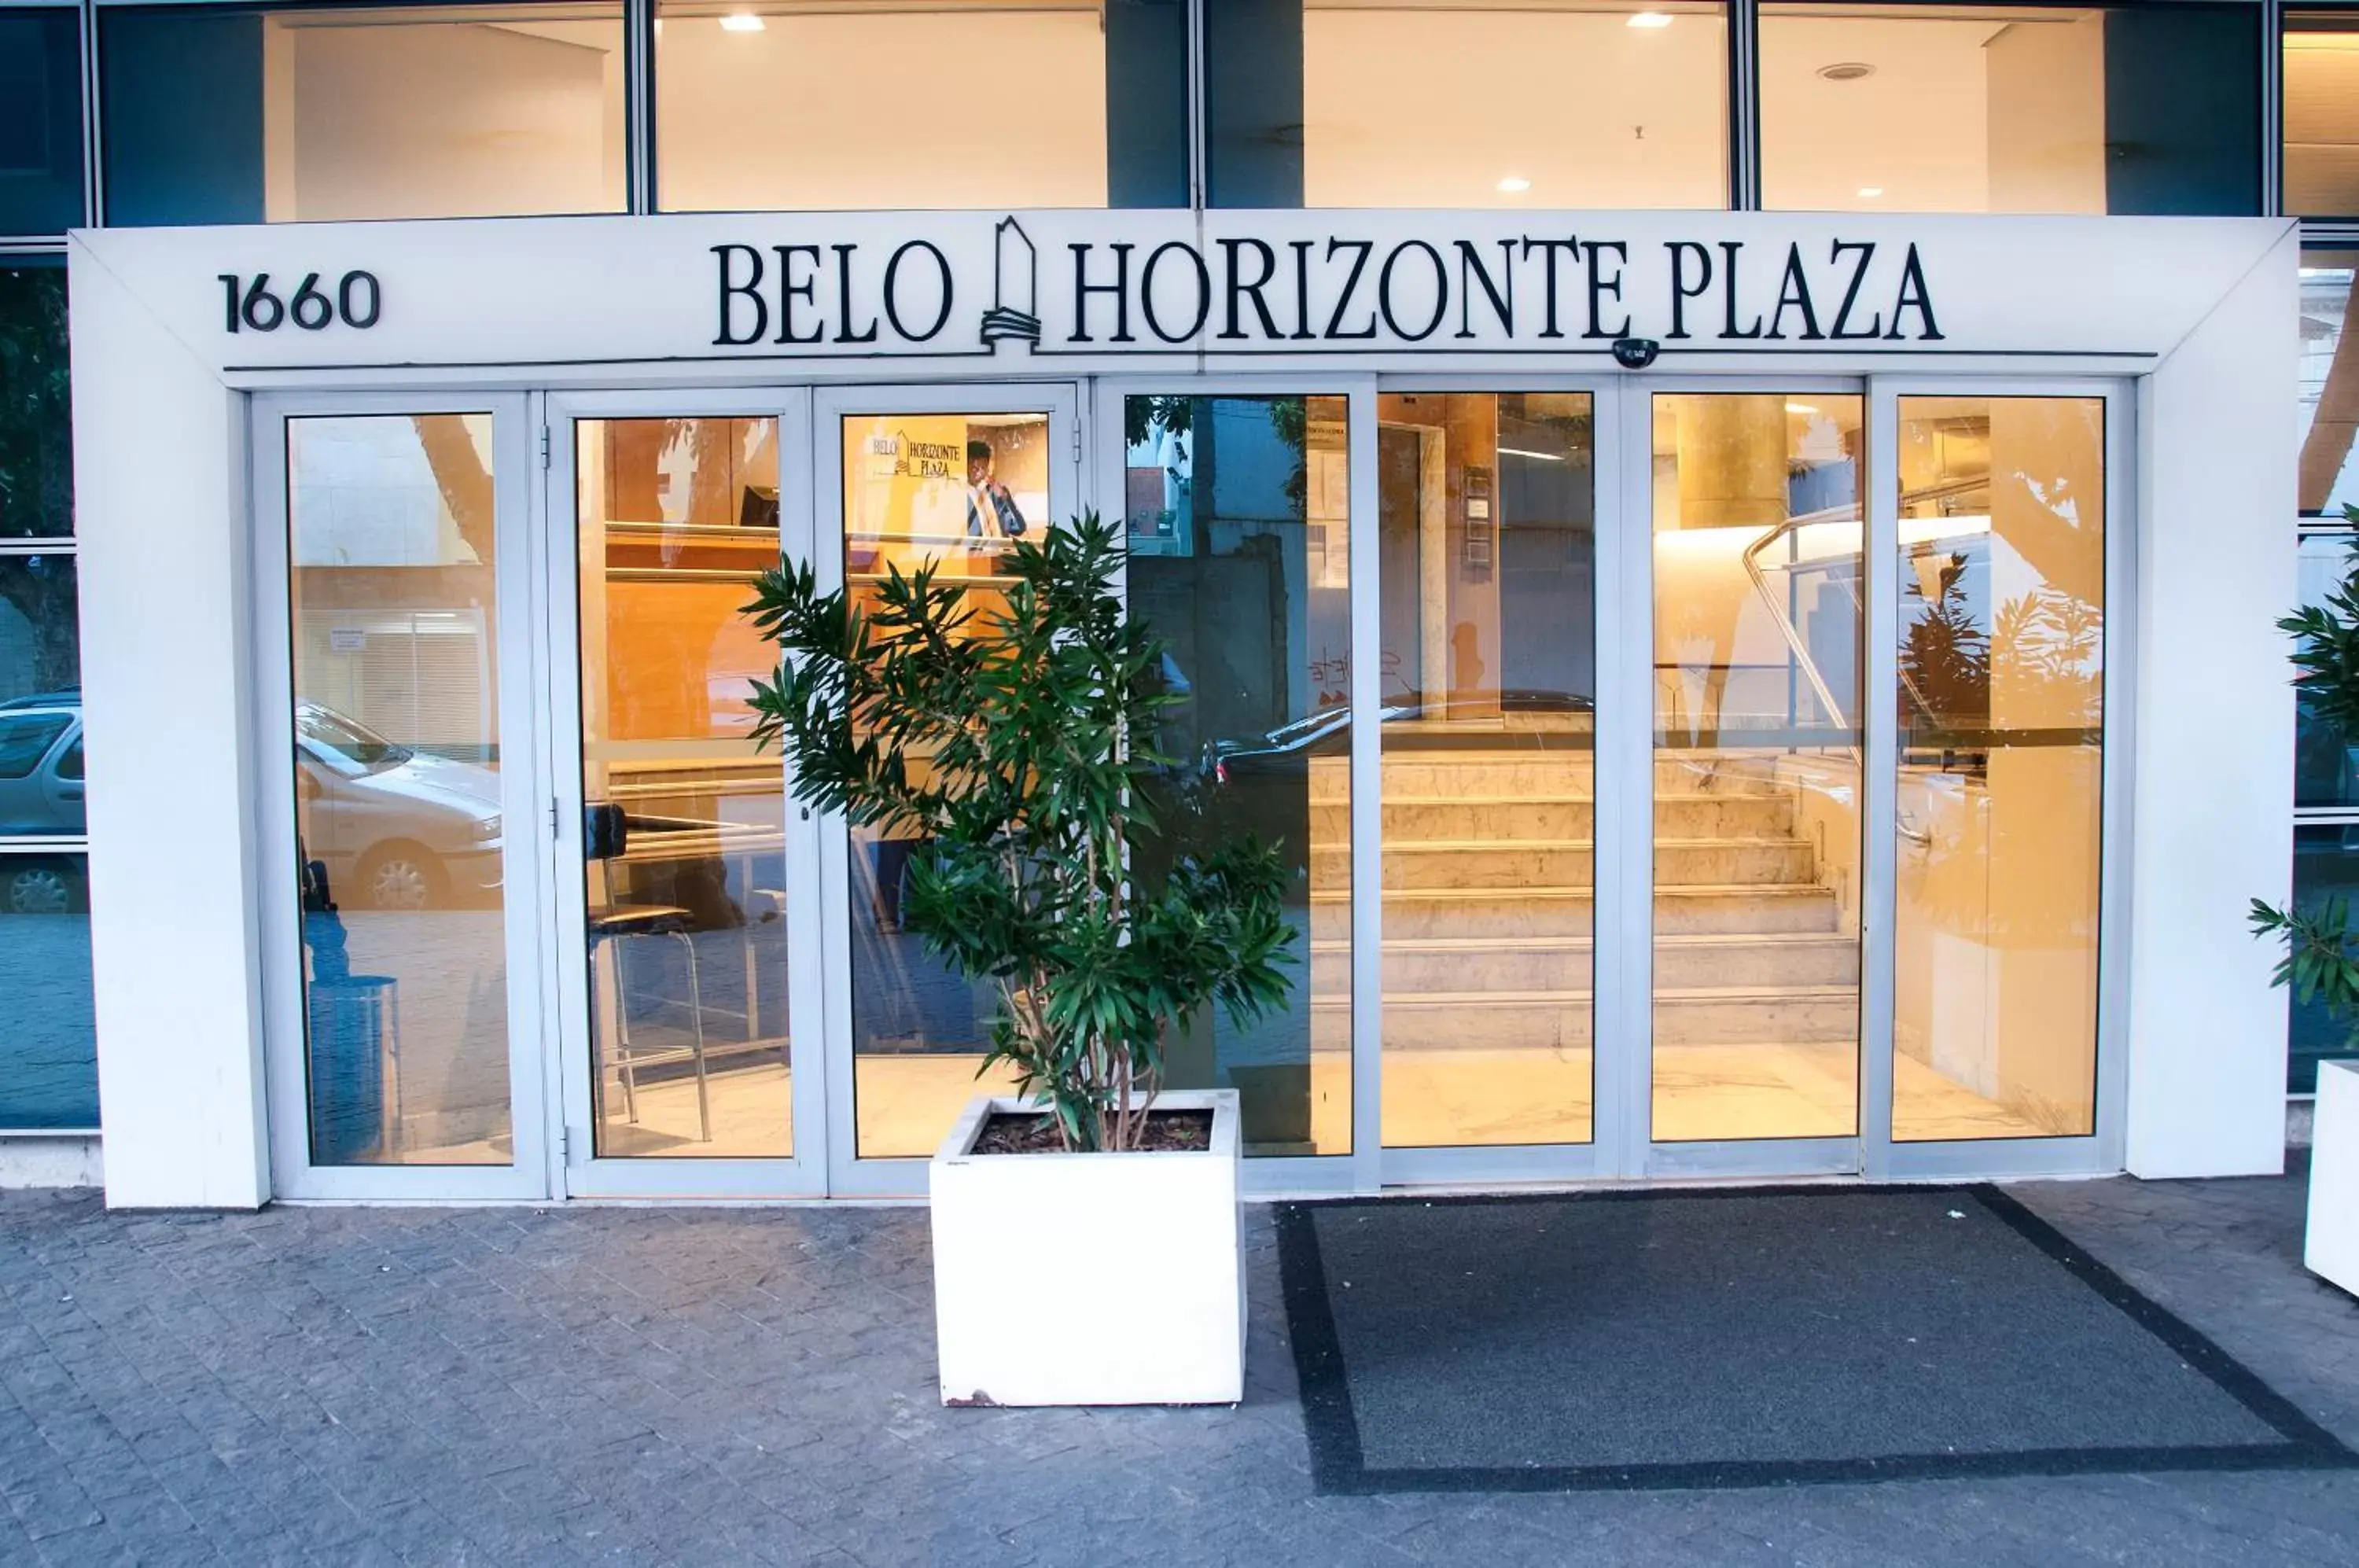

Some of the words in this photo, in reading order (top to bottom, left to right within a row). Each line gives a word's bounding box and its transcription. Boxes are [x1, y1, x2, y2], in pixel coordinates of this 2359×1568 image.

[217, 270, 381, 334] 1660
[709, 240, 953, 345] BELO
[1066, 235, 1632, 343] HORIZONTE
[1663, 237, 1946, 340] PLAZA
[874, 439, 896, 455] BELO
[910, 442, 960, 462] HORIZONTE
[921, 460, 949, 477] PLAZA
